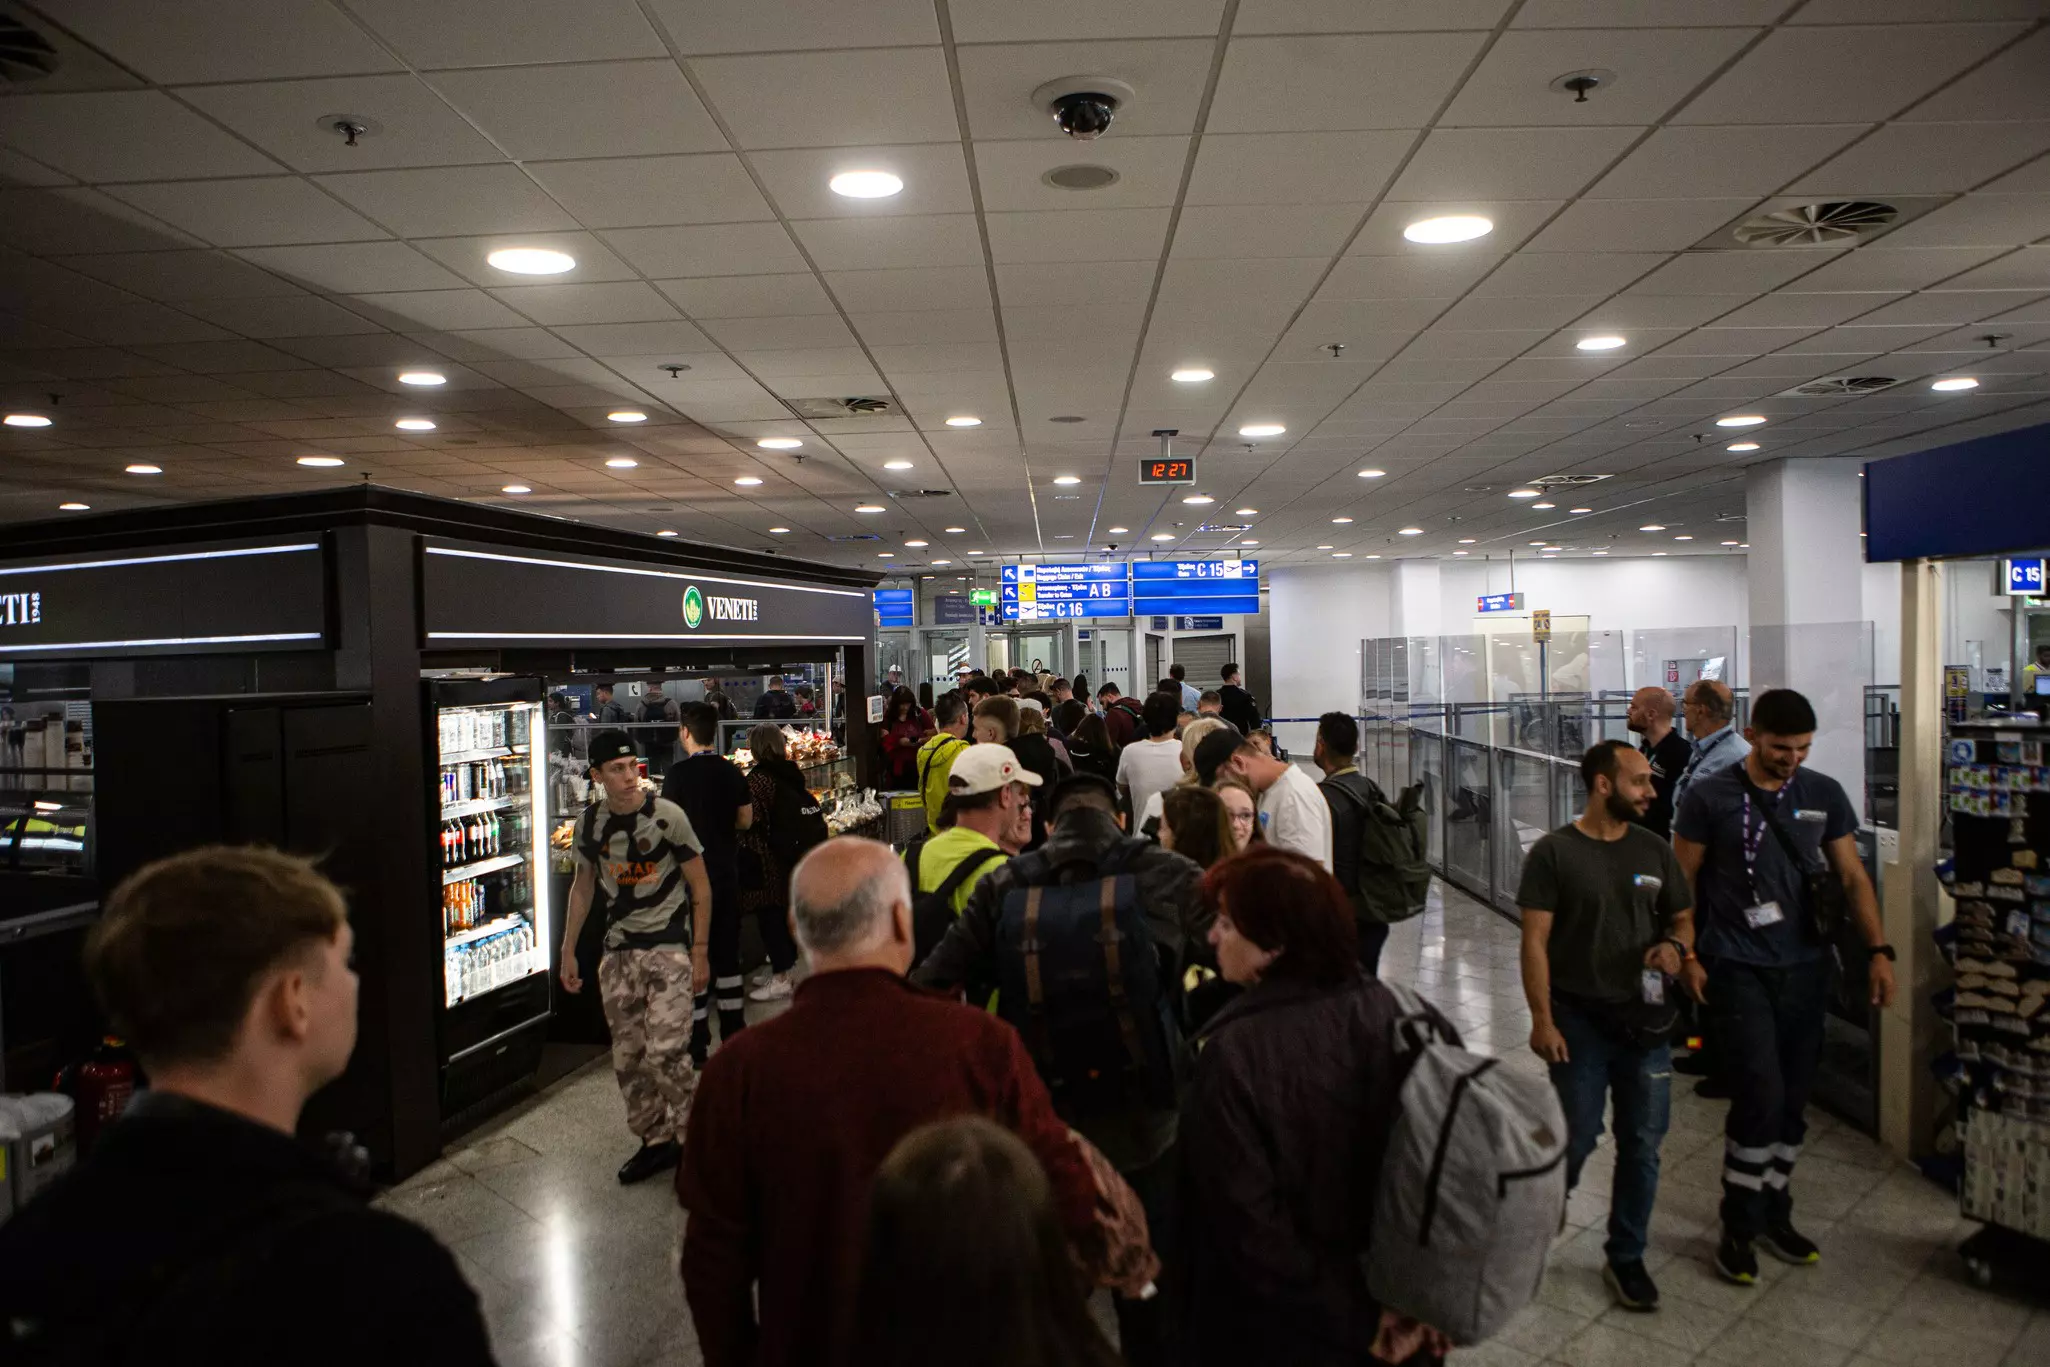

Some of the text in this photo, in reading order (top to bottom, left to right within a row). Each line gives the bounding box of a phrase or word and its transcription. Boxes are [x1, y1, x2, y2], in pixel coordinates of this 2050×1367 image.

[1197, 563, 1224, 577] C 15
[2012, 567, 2041, 583] C 15
[1089, 583, 1100, 598] A
[1102, 583, 1112, 598] B
[31, 592, 41, 624] 1948
[706, 596, 754, 621] VENETI
[1056, 602, 1084, 617] C 16
